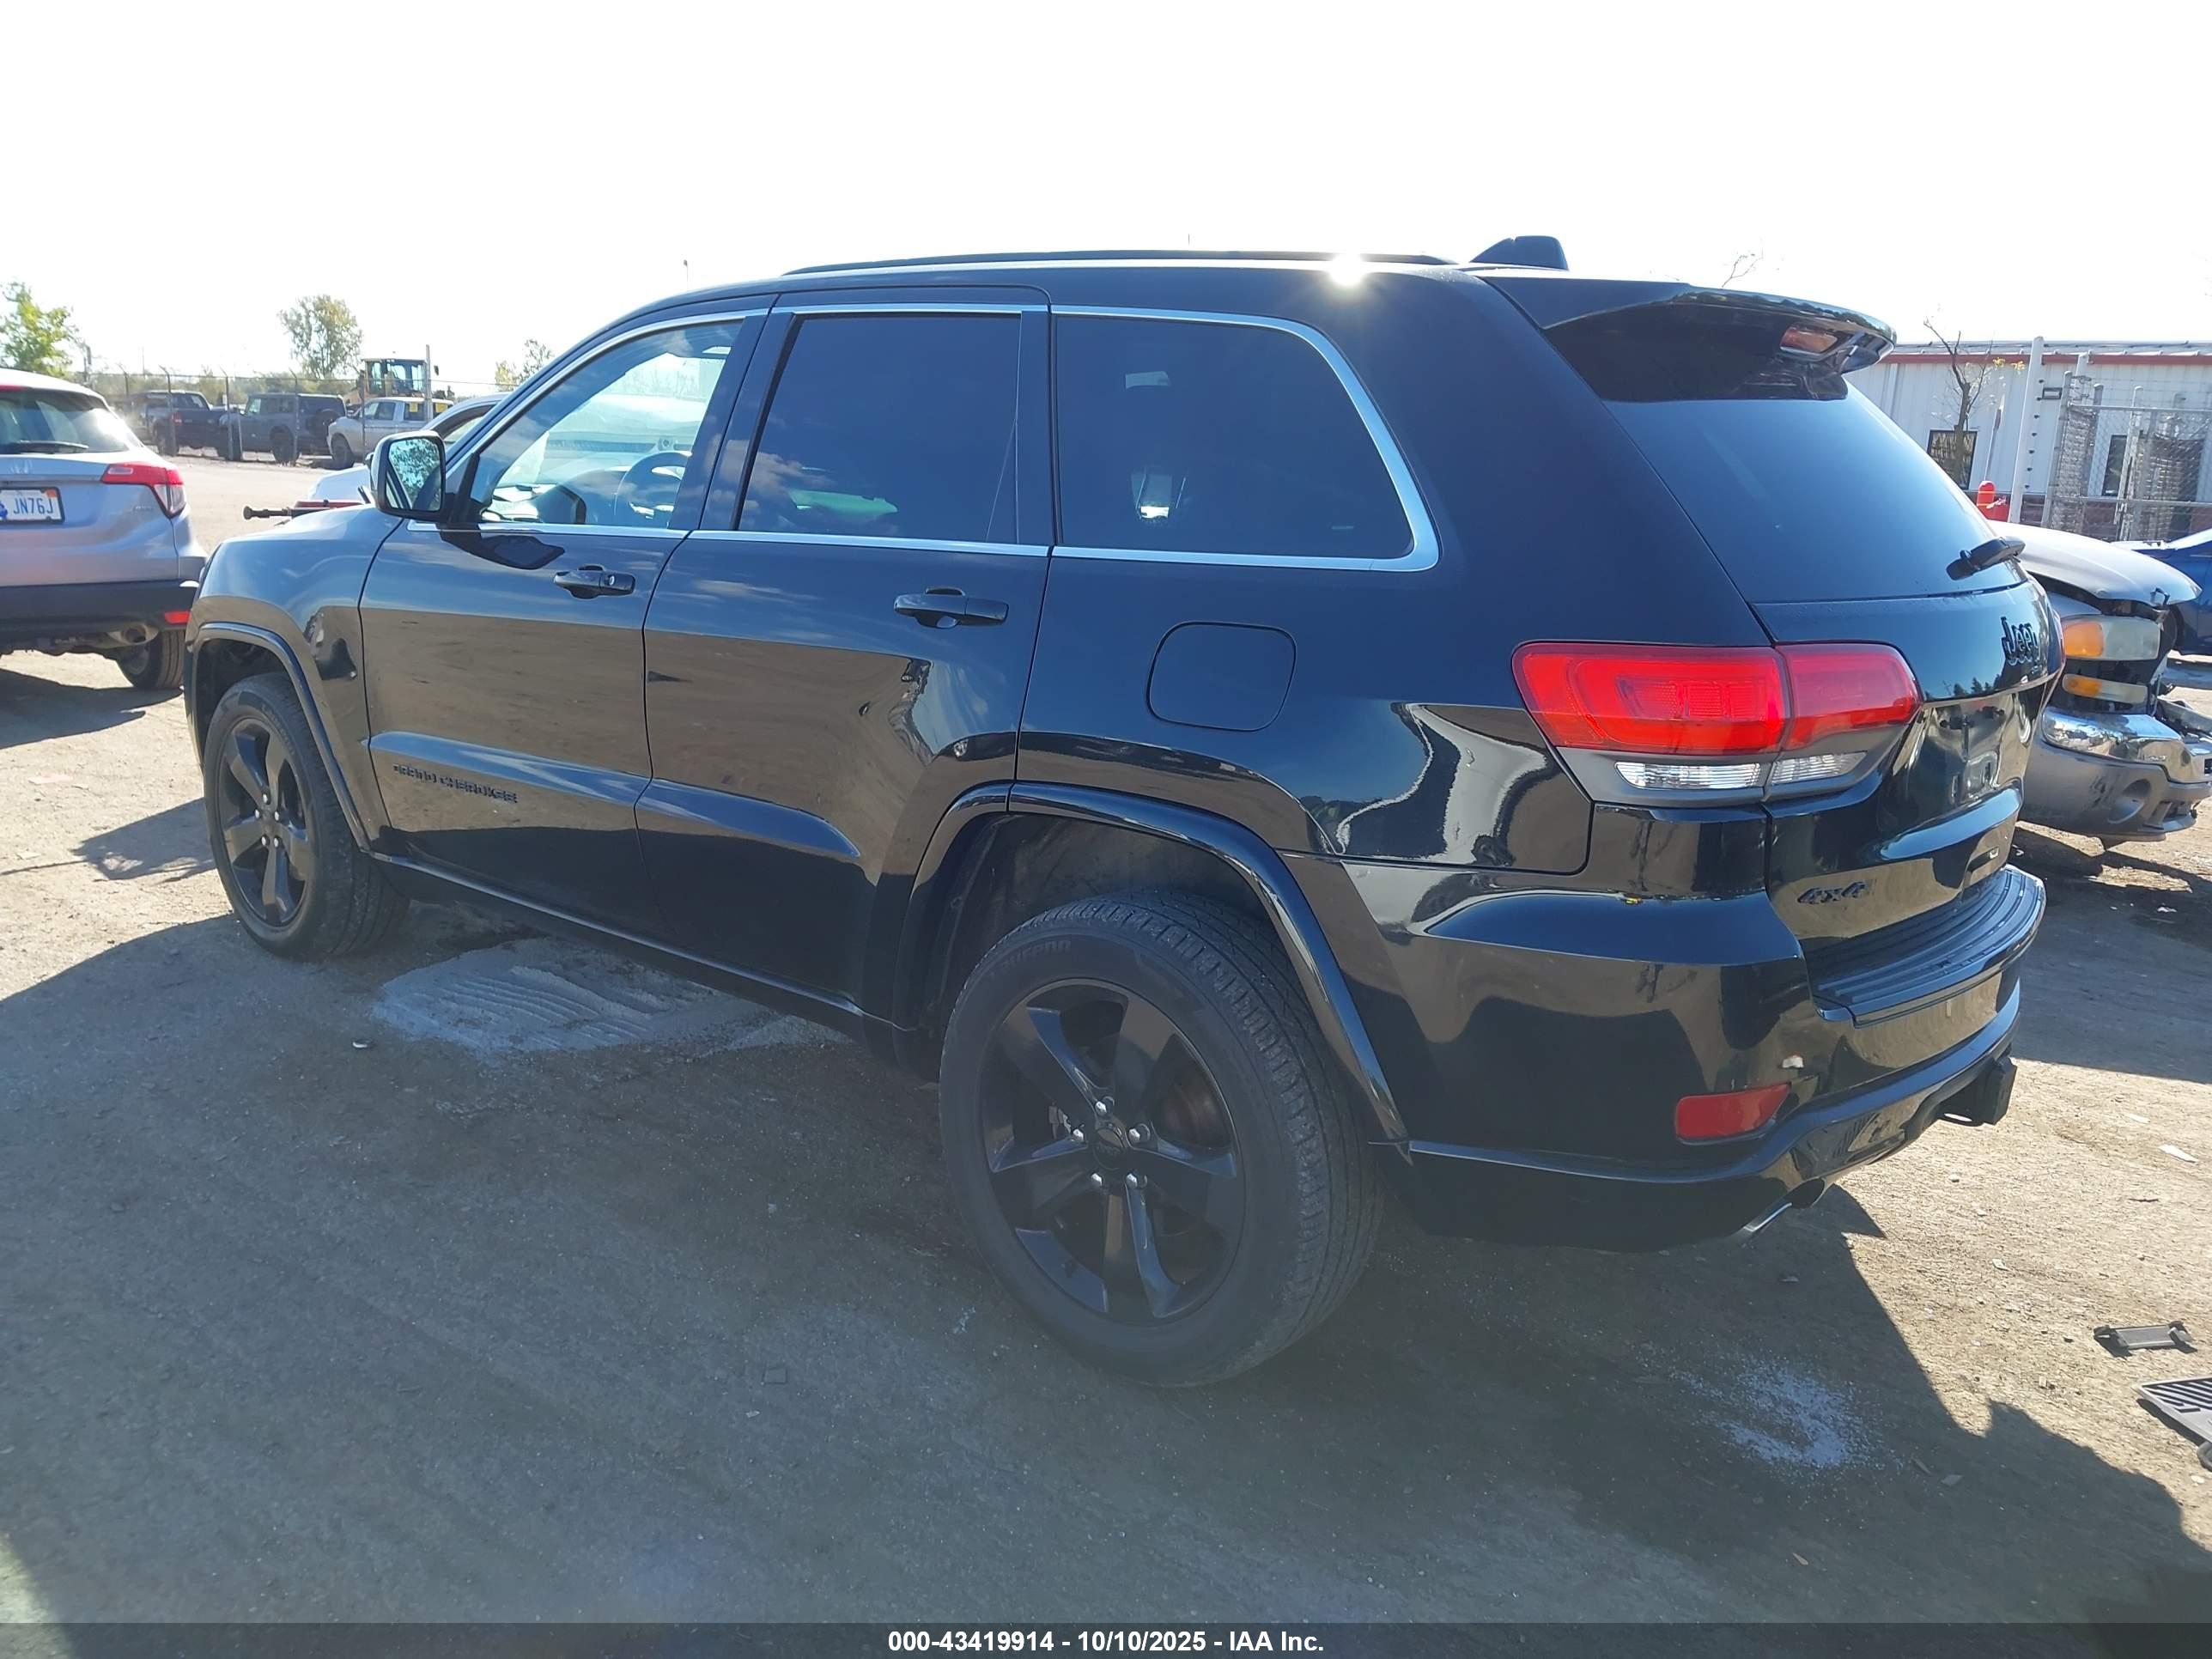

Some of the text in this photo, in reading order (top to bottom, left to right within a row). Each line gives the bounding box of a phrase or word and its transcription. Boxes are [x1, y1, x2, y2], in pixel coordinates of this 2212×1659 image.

[13, 497, 54, 514] JN76J
[1999, 615, 2040, 665] Jeep
[1796, 880, 1869, 905] 4x4
